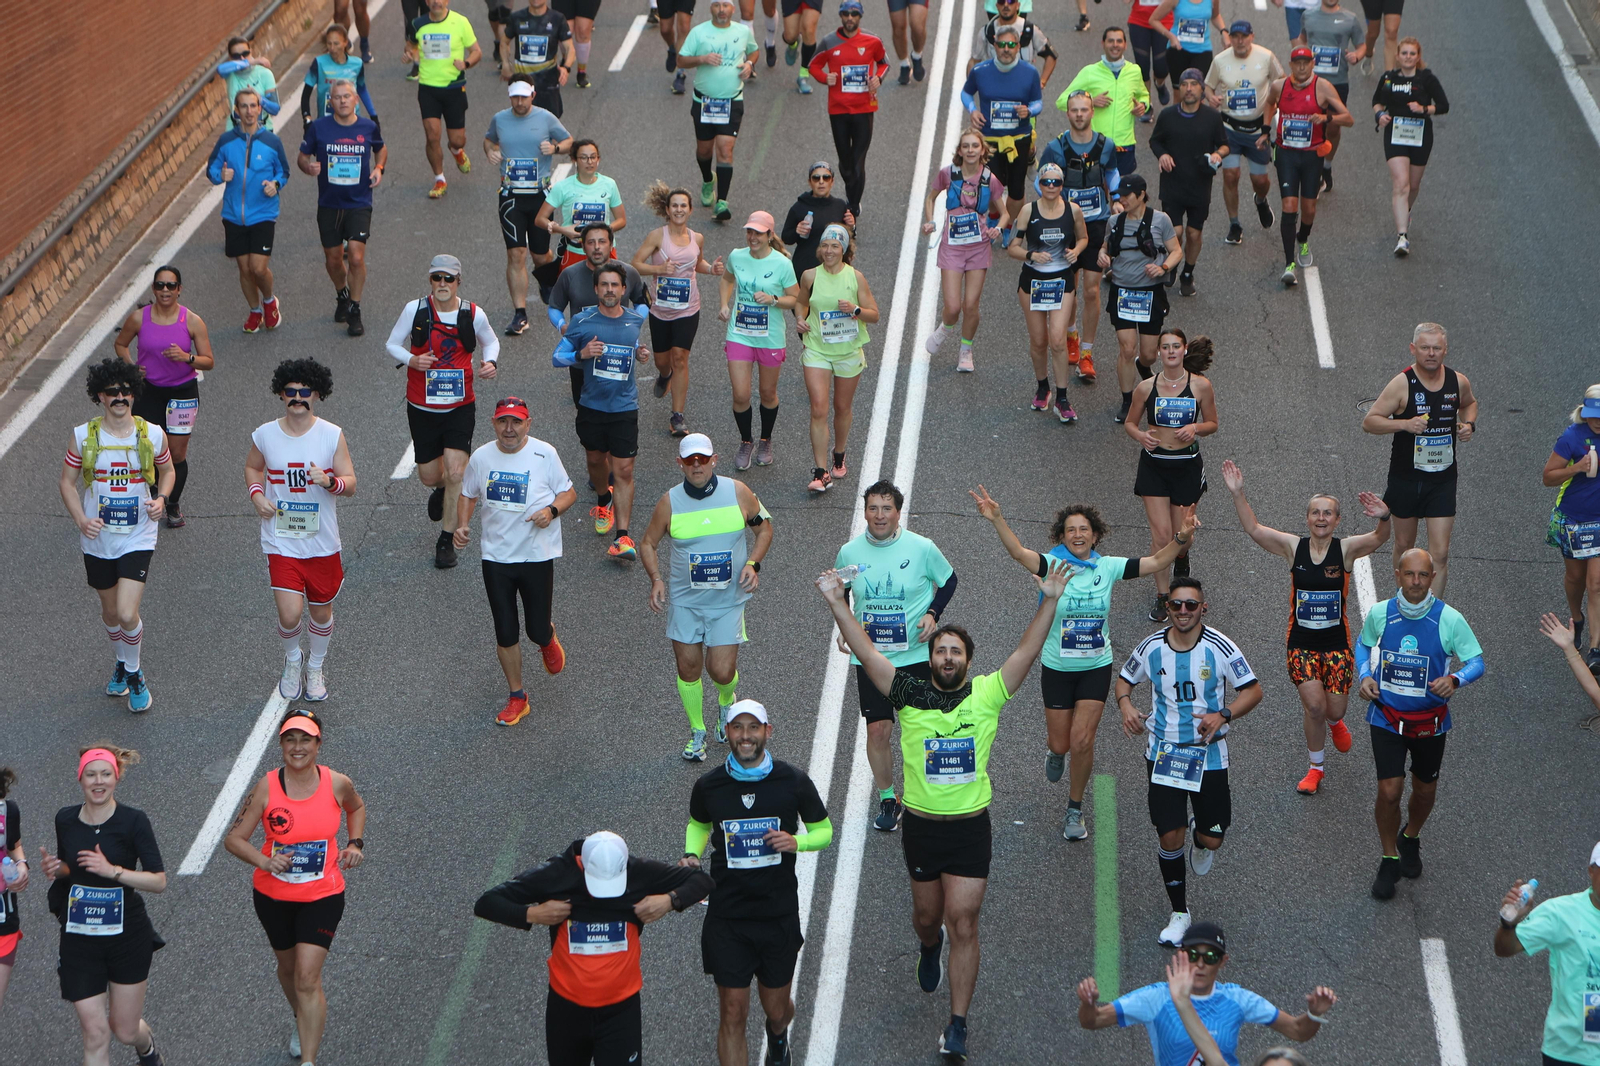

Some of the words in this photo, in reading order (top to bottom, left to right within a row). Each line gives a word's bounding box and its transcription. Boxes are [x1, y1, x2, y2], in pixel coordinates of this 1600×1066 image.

[326, 144, 365, 153] FINISHER
[957, 215, 975, 223] ZURICH
[609, 345, 631, 354] ZURICH
[607, 358, 622, 366] 13004
[109, 468, 128, 487] 118
[286, 469, 307, 488] 118
[498, 486, 515, 494] 12114
[704, 554, 727, 562] ZURICH
[875, 628, 893, 636] 12049
[1397, 656, 1423, 665] ZURICH
[1394, 669, 1413, 678] 13036
[1390, 677, 1415, 687] MASSIMO
[1173, 680, 1197, 703] 10
[942, 741, 969, 749] ZURICH
[1174, 747, 1200, 757] ZURICH
[940, 756, 960, 765] 11461
[1170, 760, 1189, 770] 12915
[939, 766, 964, 774] MORENO
[1169, 770, 1185, 778] FIDEL
[742, 838, 764, 847] 11483
[748, 849, 760, 857] FER
[291, 866, 303, 874] BEL
[86, 891, 116, 899] ZURICH
[83, 906, 106, 915] 12719
[85, 917, 103, 925] NONE
[586, 923, 610, 932] 12315
